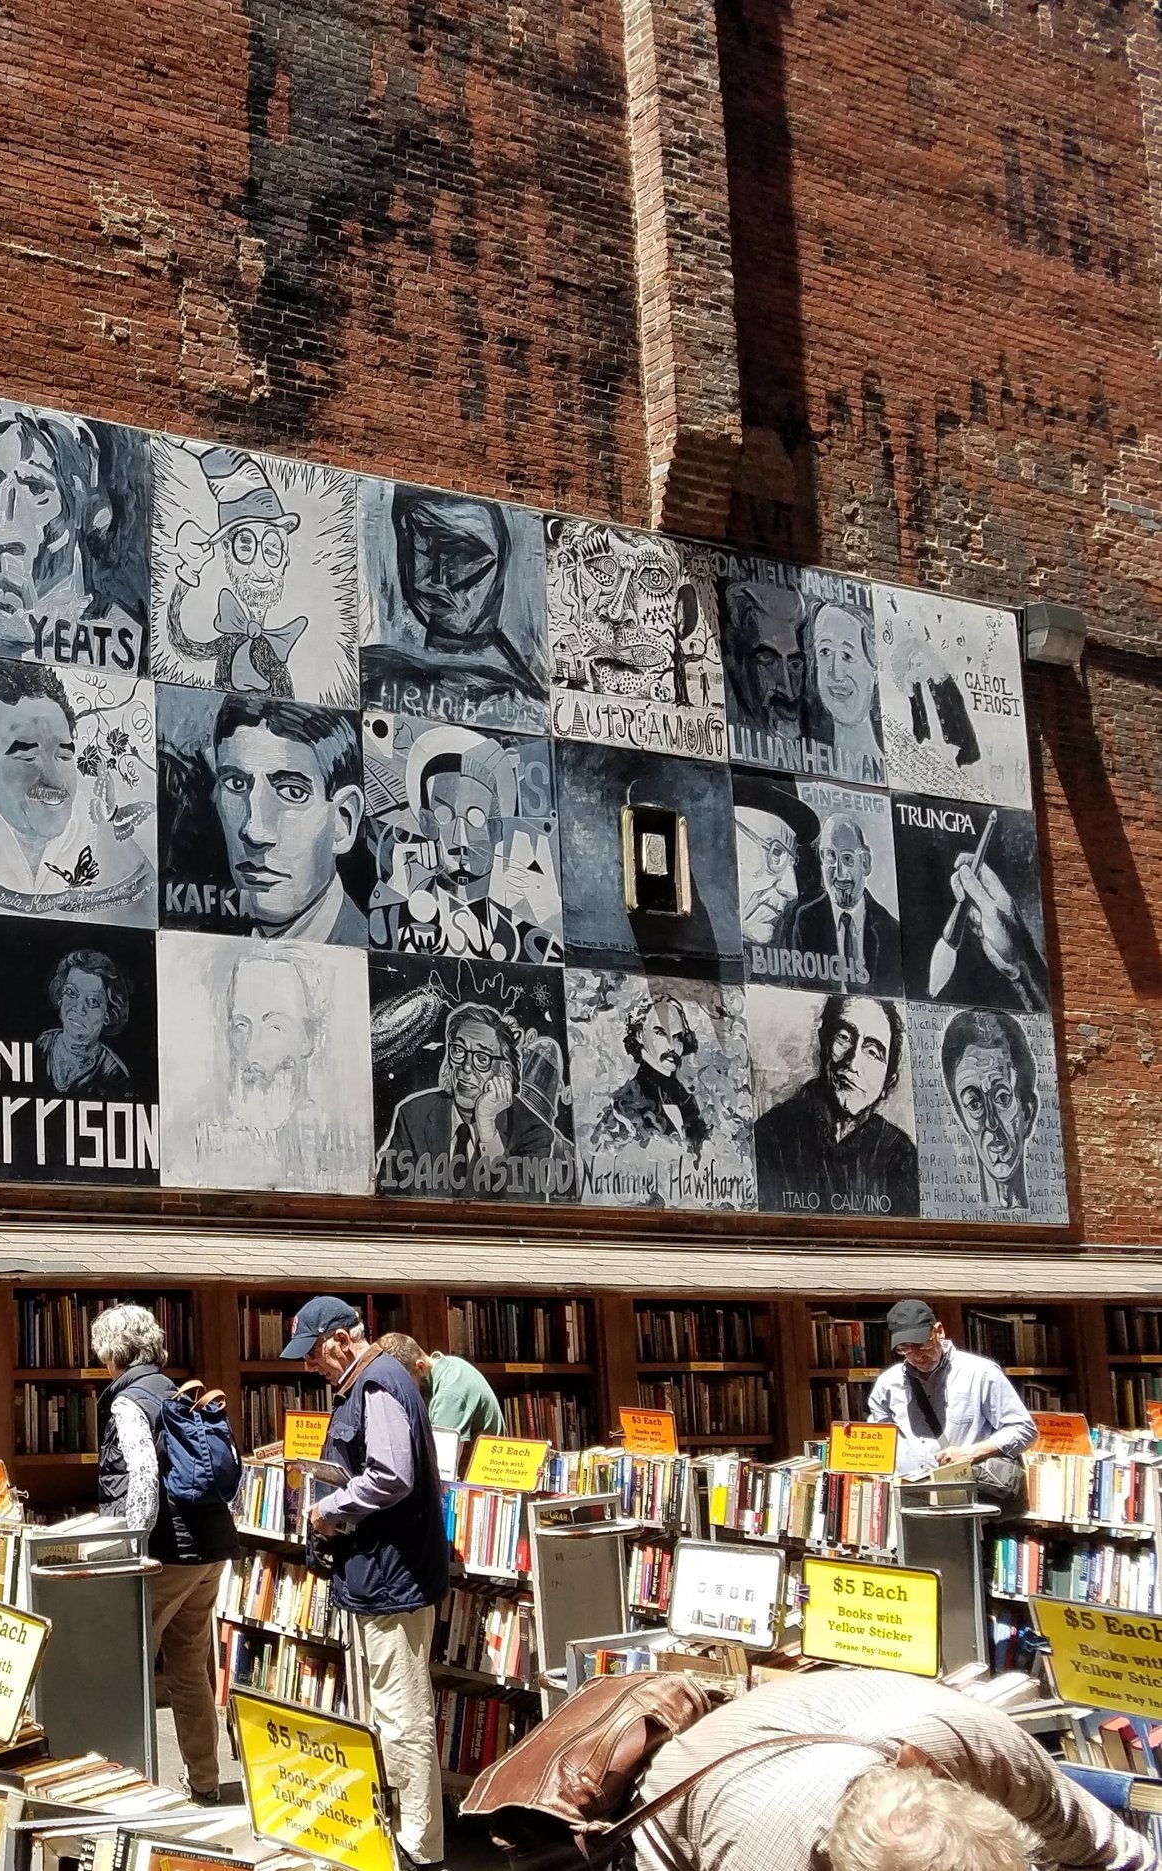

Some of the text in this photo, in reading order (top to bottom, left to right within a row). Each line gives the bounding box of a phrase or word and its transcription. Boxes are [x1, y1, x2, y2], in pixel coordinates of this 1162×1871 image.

[28, 613, 137, 671] YEATS
[964, 671, 1014, 696] CAROL
[970, 691, 1021, 717] FROST
[728, 724, 802, 773] LILLIAN
[801, 786, 885, 814] GINSBERG
[896, 803, 977, 835] TRUNGPA
[751, 945, 871, 985] BURROUGHS
[908, 1018, 932, 1031] Juan
[378, 1150, 575, 1195] ISAAC ASIMOV
[669, 1154, 754, 1201] Hawthorne
[782, 1191, 892, 1214] ITALO CALVINO
[296, 1420, 322, 1429] $3 Each
[632, 1416, 662, 1426] $3 Each
[860, 1432, 883, 1440] Each
[491, 1445, 531, 1457] $3 Each
[482, 1466, 503, 1474] Orange
[833, 1575, 909, 1602] $5 Each
[838, 1606, 903, 1625] Books with
[1063, 1606, 1096, 1631] $5
[828, 1620, 913, 1643] Yellow Sticker
[835, 1641, 903, 1659] Please Pay Inside
[1078, 1643, 1129, 1664] Books
[1070, 1659, 1123, 1681] Yellow
[1087, 1685, 1145, 1707] Please Pay
[266, 1719, 349, 1769] $5 Each
[278, 1764, 348, 1803] Books with
[272, 1784, 363, 1830] Yellow Sticker
[285, 1816, 359, 1853] Please Pay Inside
